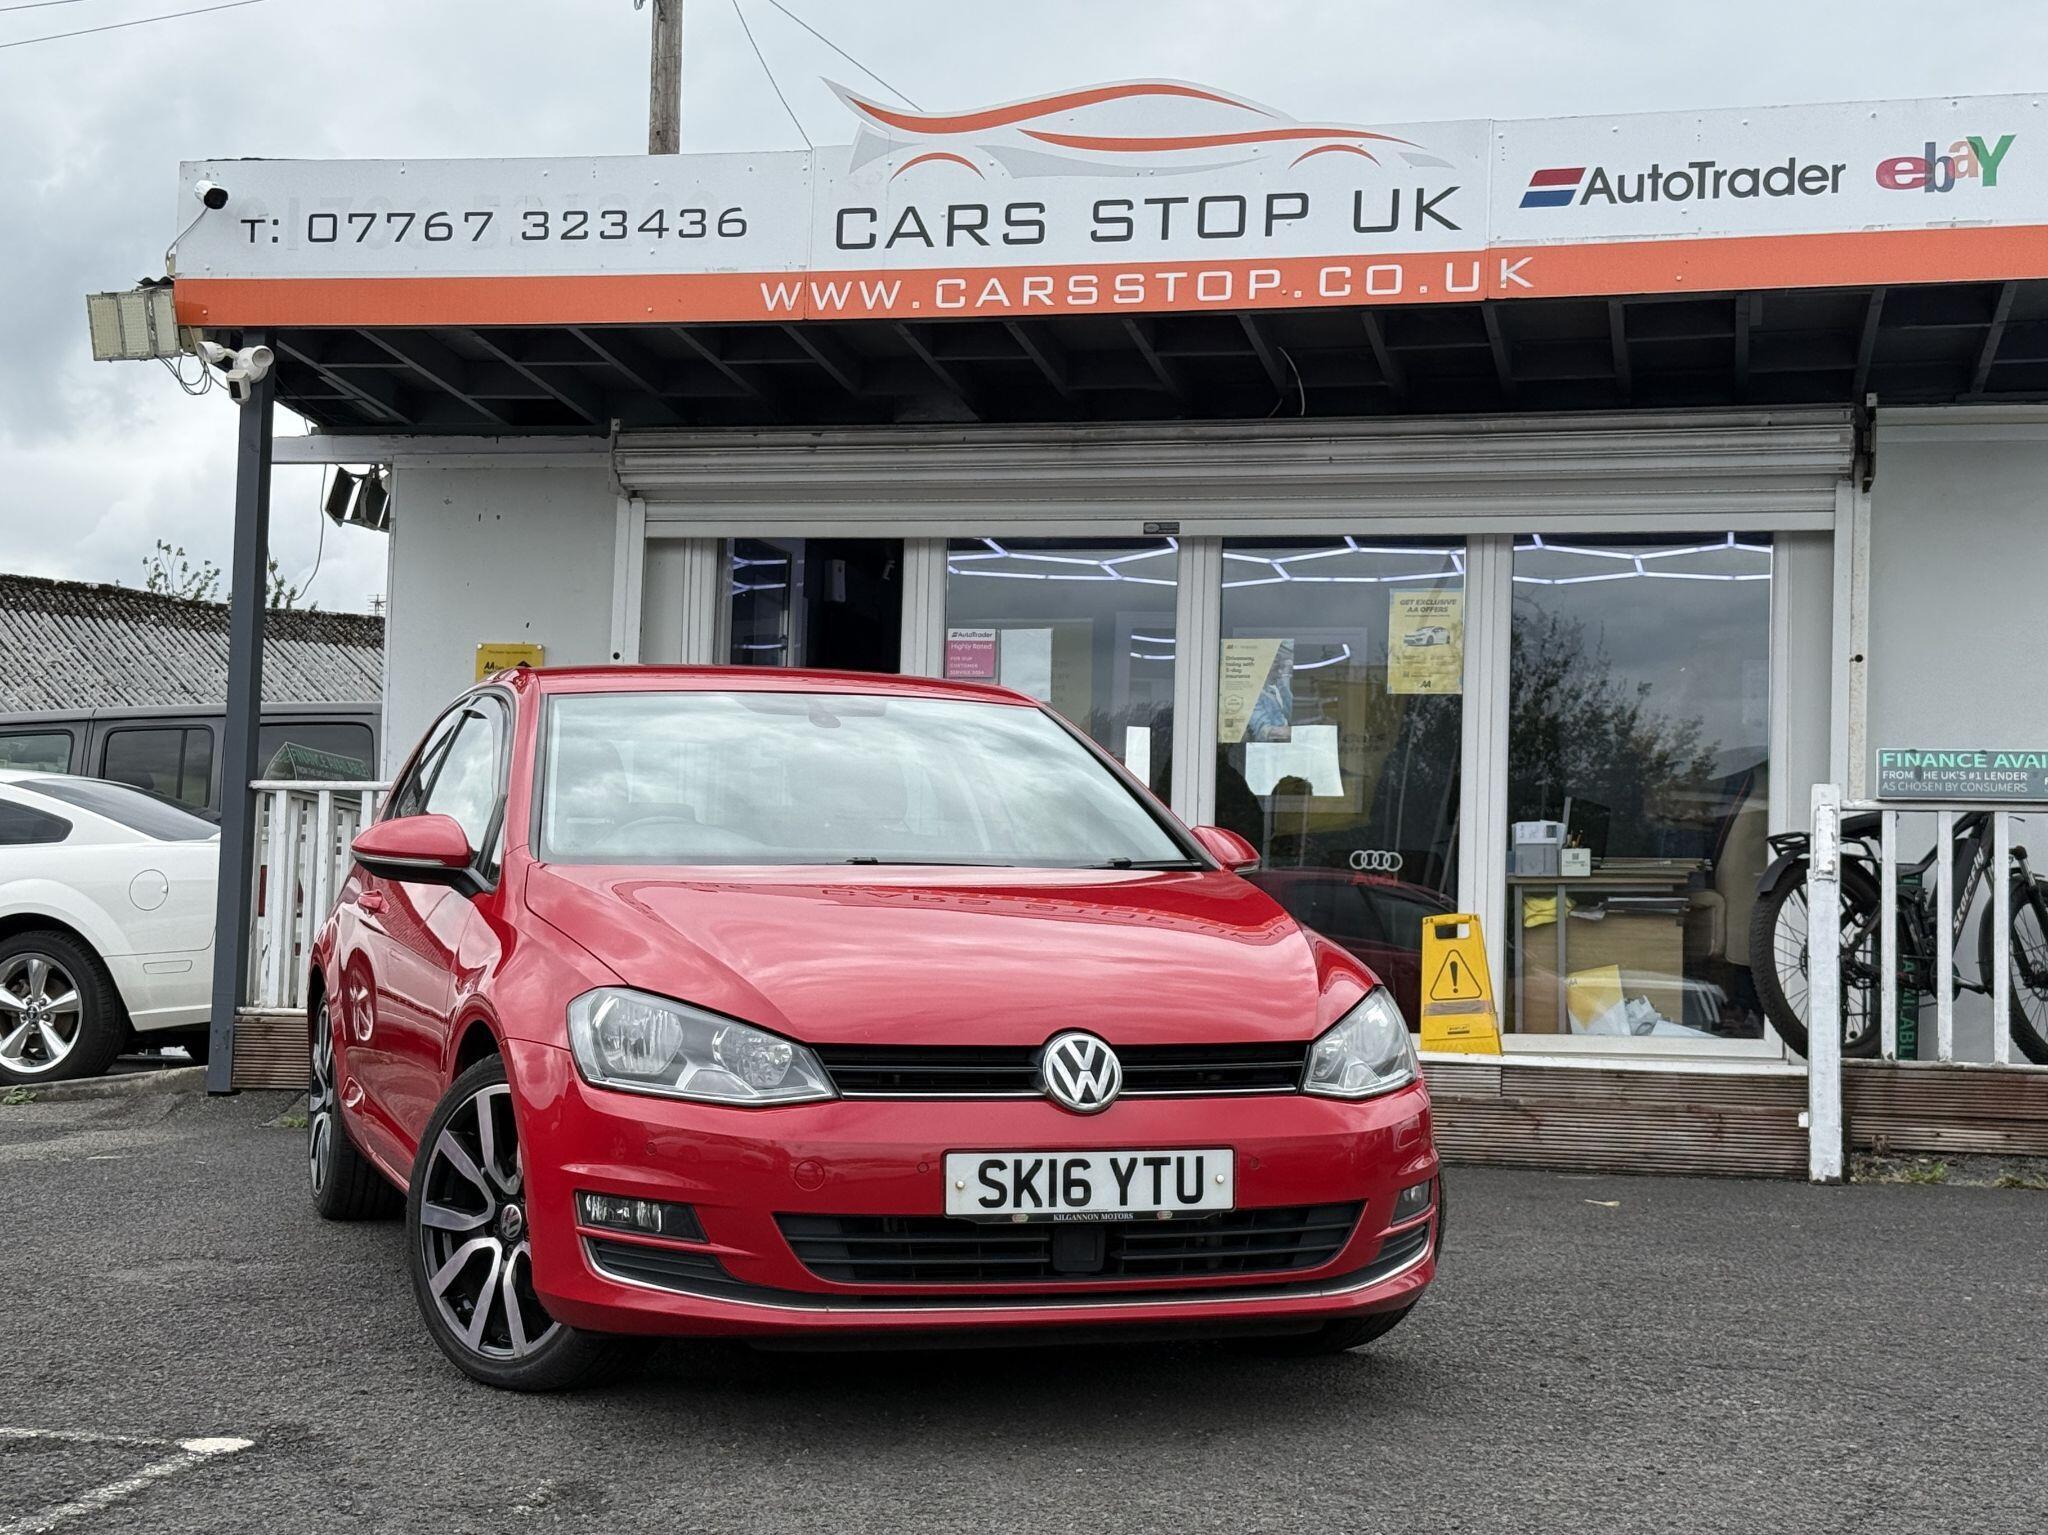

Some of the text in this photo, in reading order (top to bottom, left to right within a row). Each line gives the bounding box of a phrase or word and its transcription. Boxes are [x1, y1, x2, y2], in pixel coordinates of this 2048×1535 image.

[1580, 157, 1846, 205] AutoTrader
[241, 207, 747, 244] T: 07767 323436
[836, 186, 1462, 250] CARS STOP UK
[1882, 752, 1988, 769] FINANCE
[1882, 770, 1914, 780] FROM
[1940, 770, 1967, 781] UK'S
[1968, 771, 1982, 781] #1
[1984, 771, 2028, 781] LENDER
[1882, 781, 2028, 792] AS CHOSEN BY CONSUMERS
[978, 1155, 1204, 1208] SK16 YTU
[1053, 1212, 1134, 1221] KILGANNON MOTORS
